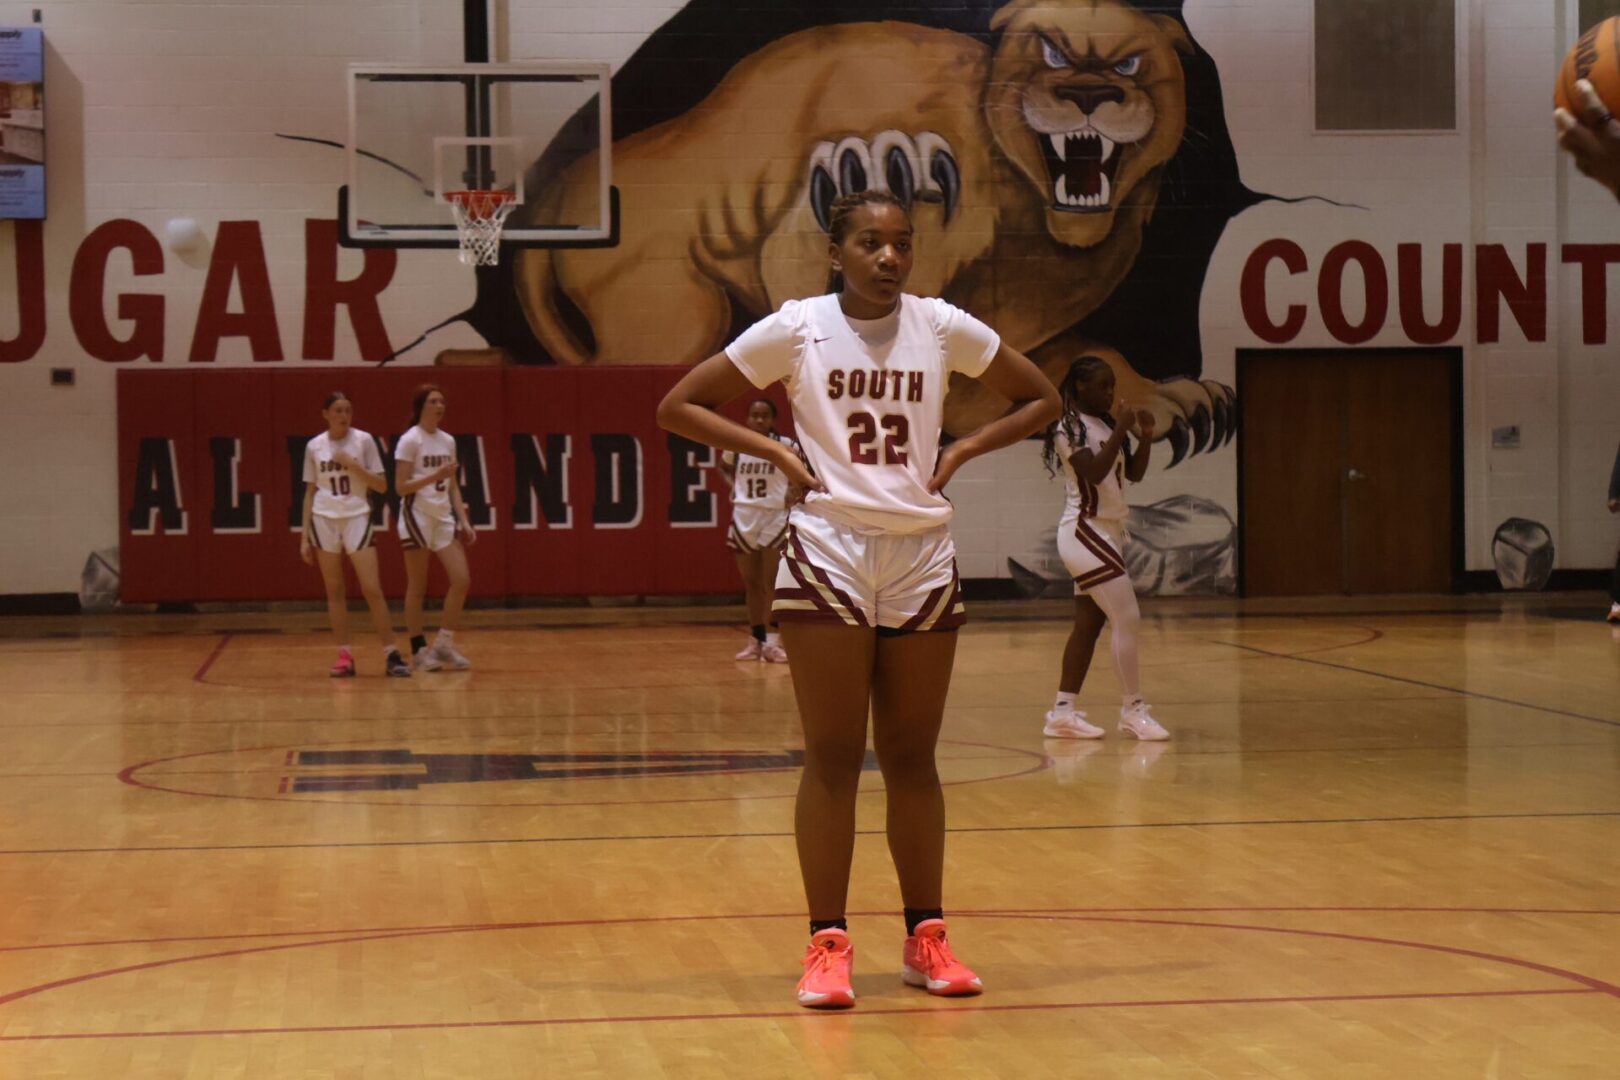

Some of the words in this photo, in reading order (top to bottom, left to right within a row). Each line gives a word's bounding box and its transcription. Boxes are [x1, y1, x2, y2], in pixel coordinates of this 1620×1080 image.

[1240, 238, 1620, 344] COUNT
[828, 369, 924, 402] SOUTH
[847, 412, 909, 467] 22
[740, 462, 775, 475] SOUTH
[329, 475, 351, 496] 10
[747, 478, 767, 499] 12
